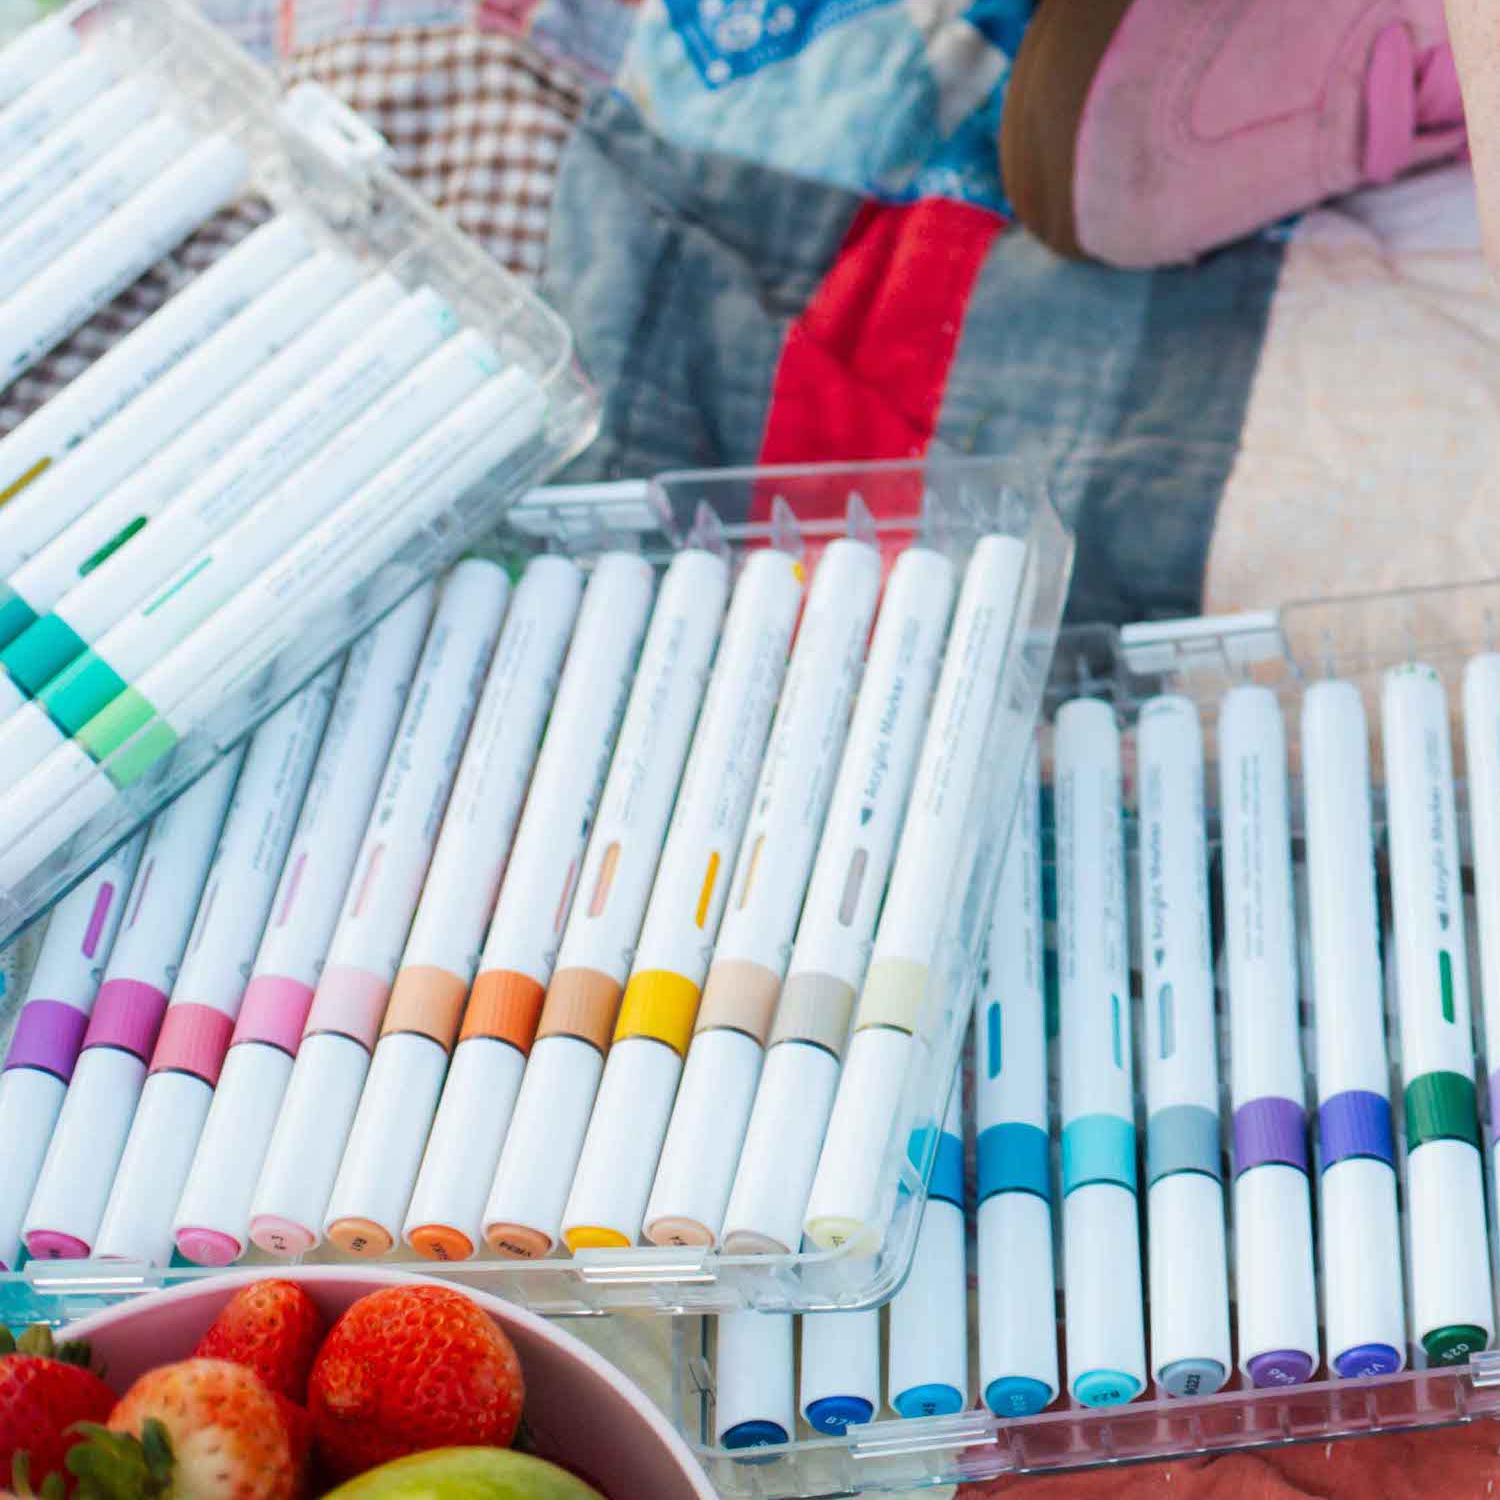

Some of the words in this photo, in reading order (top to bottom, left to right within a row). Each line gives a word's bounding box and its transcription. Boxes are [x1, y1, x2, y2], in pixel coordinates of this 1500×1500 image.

[864, 741, 890, 799] Acrylic
[881, 675, 905, 734] Marker
[1433, 848, 1450, 906] Acrylic
